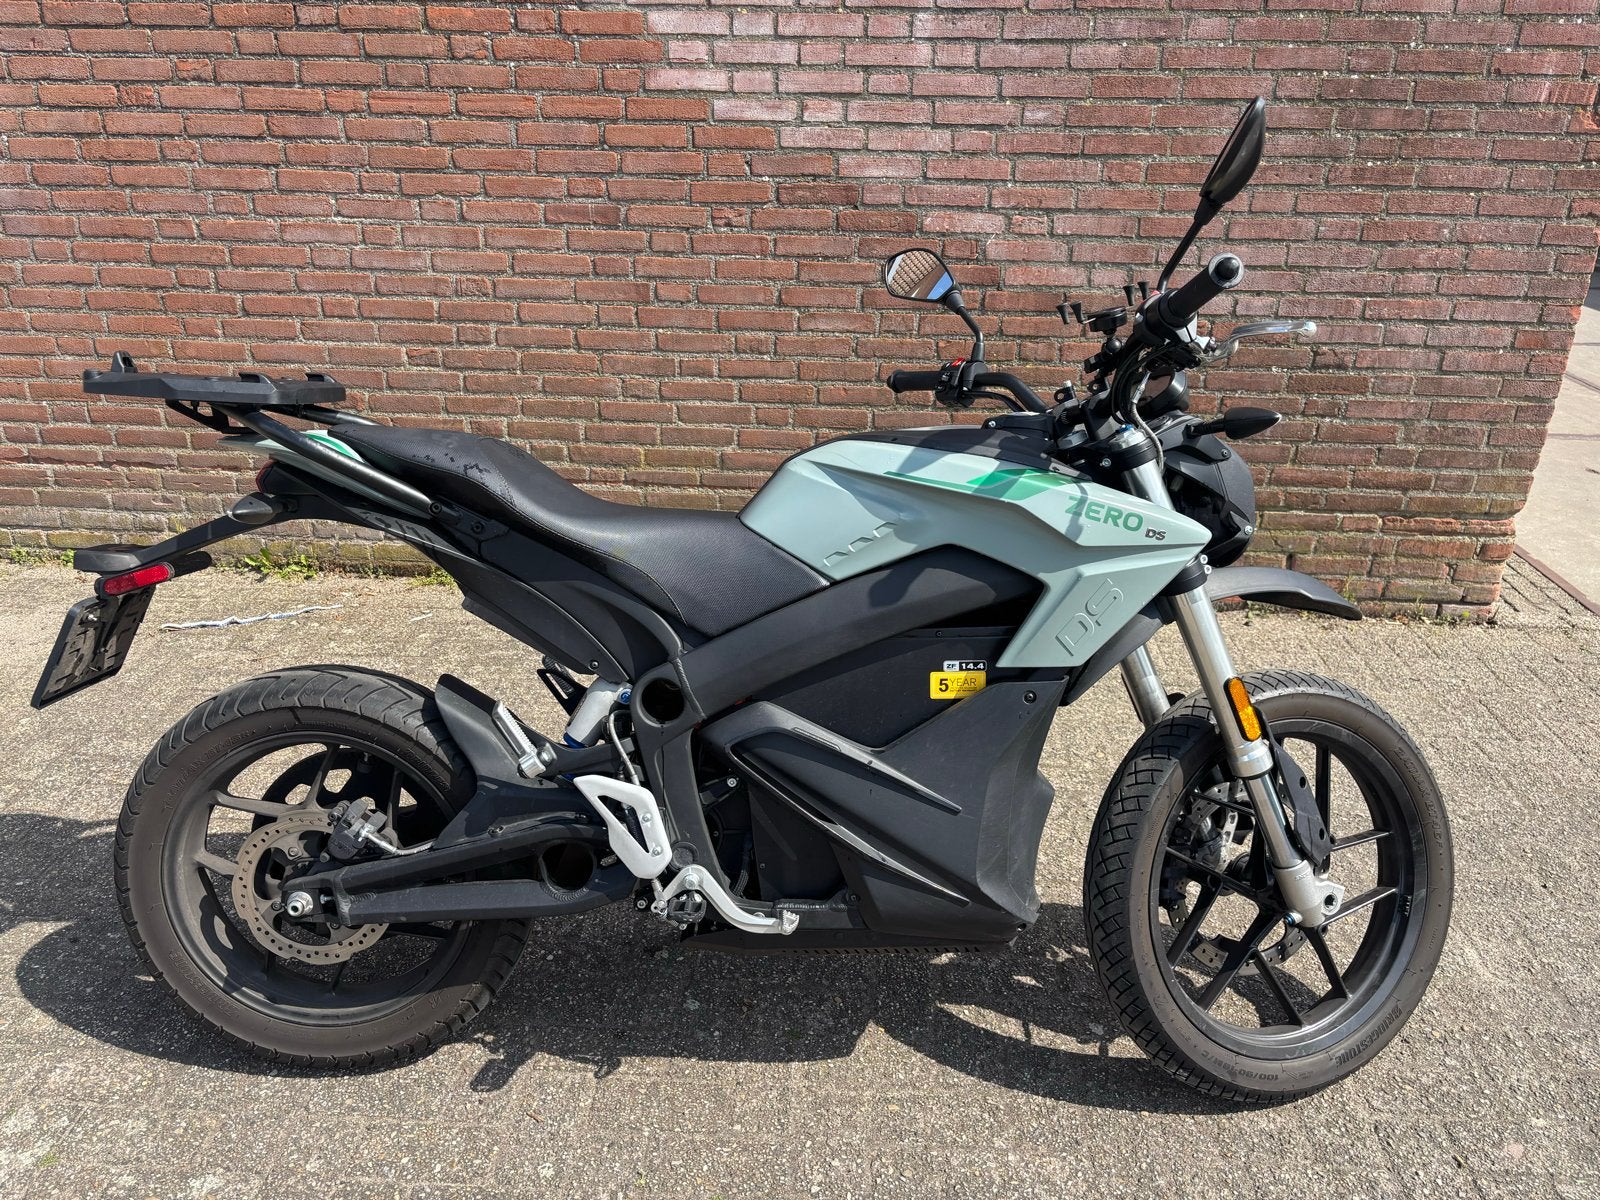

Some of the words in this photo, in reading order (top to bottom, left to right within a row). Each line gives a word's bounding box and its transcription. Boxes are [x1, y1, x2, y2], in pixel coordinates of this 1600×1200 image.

[1065, 495, 1144, 532] ZERO
[1144, 527, 1167, 541] DS
[1055, 577, 1124, 657] DS
[938, 678, 949, 693] 5
[949, 677, 977, 687] YEAR
[961, 662, 984, 670] 14.4
[1334, 1007, 1402, 1068] BRIDGESTONE
